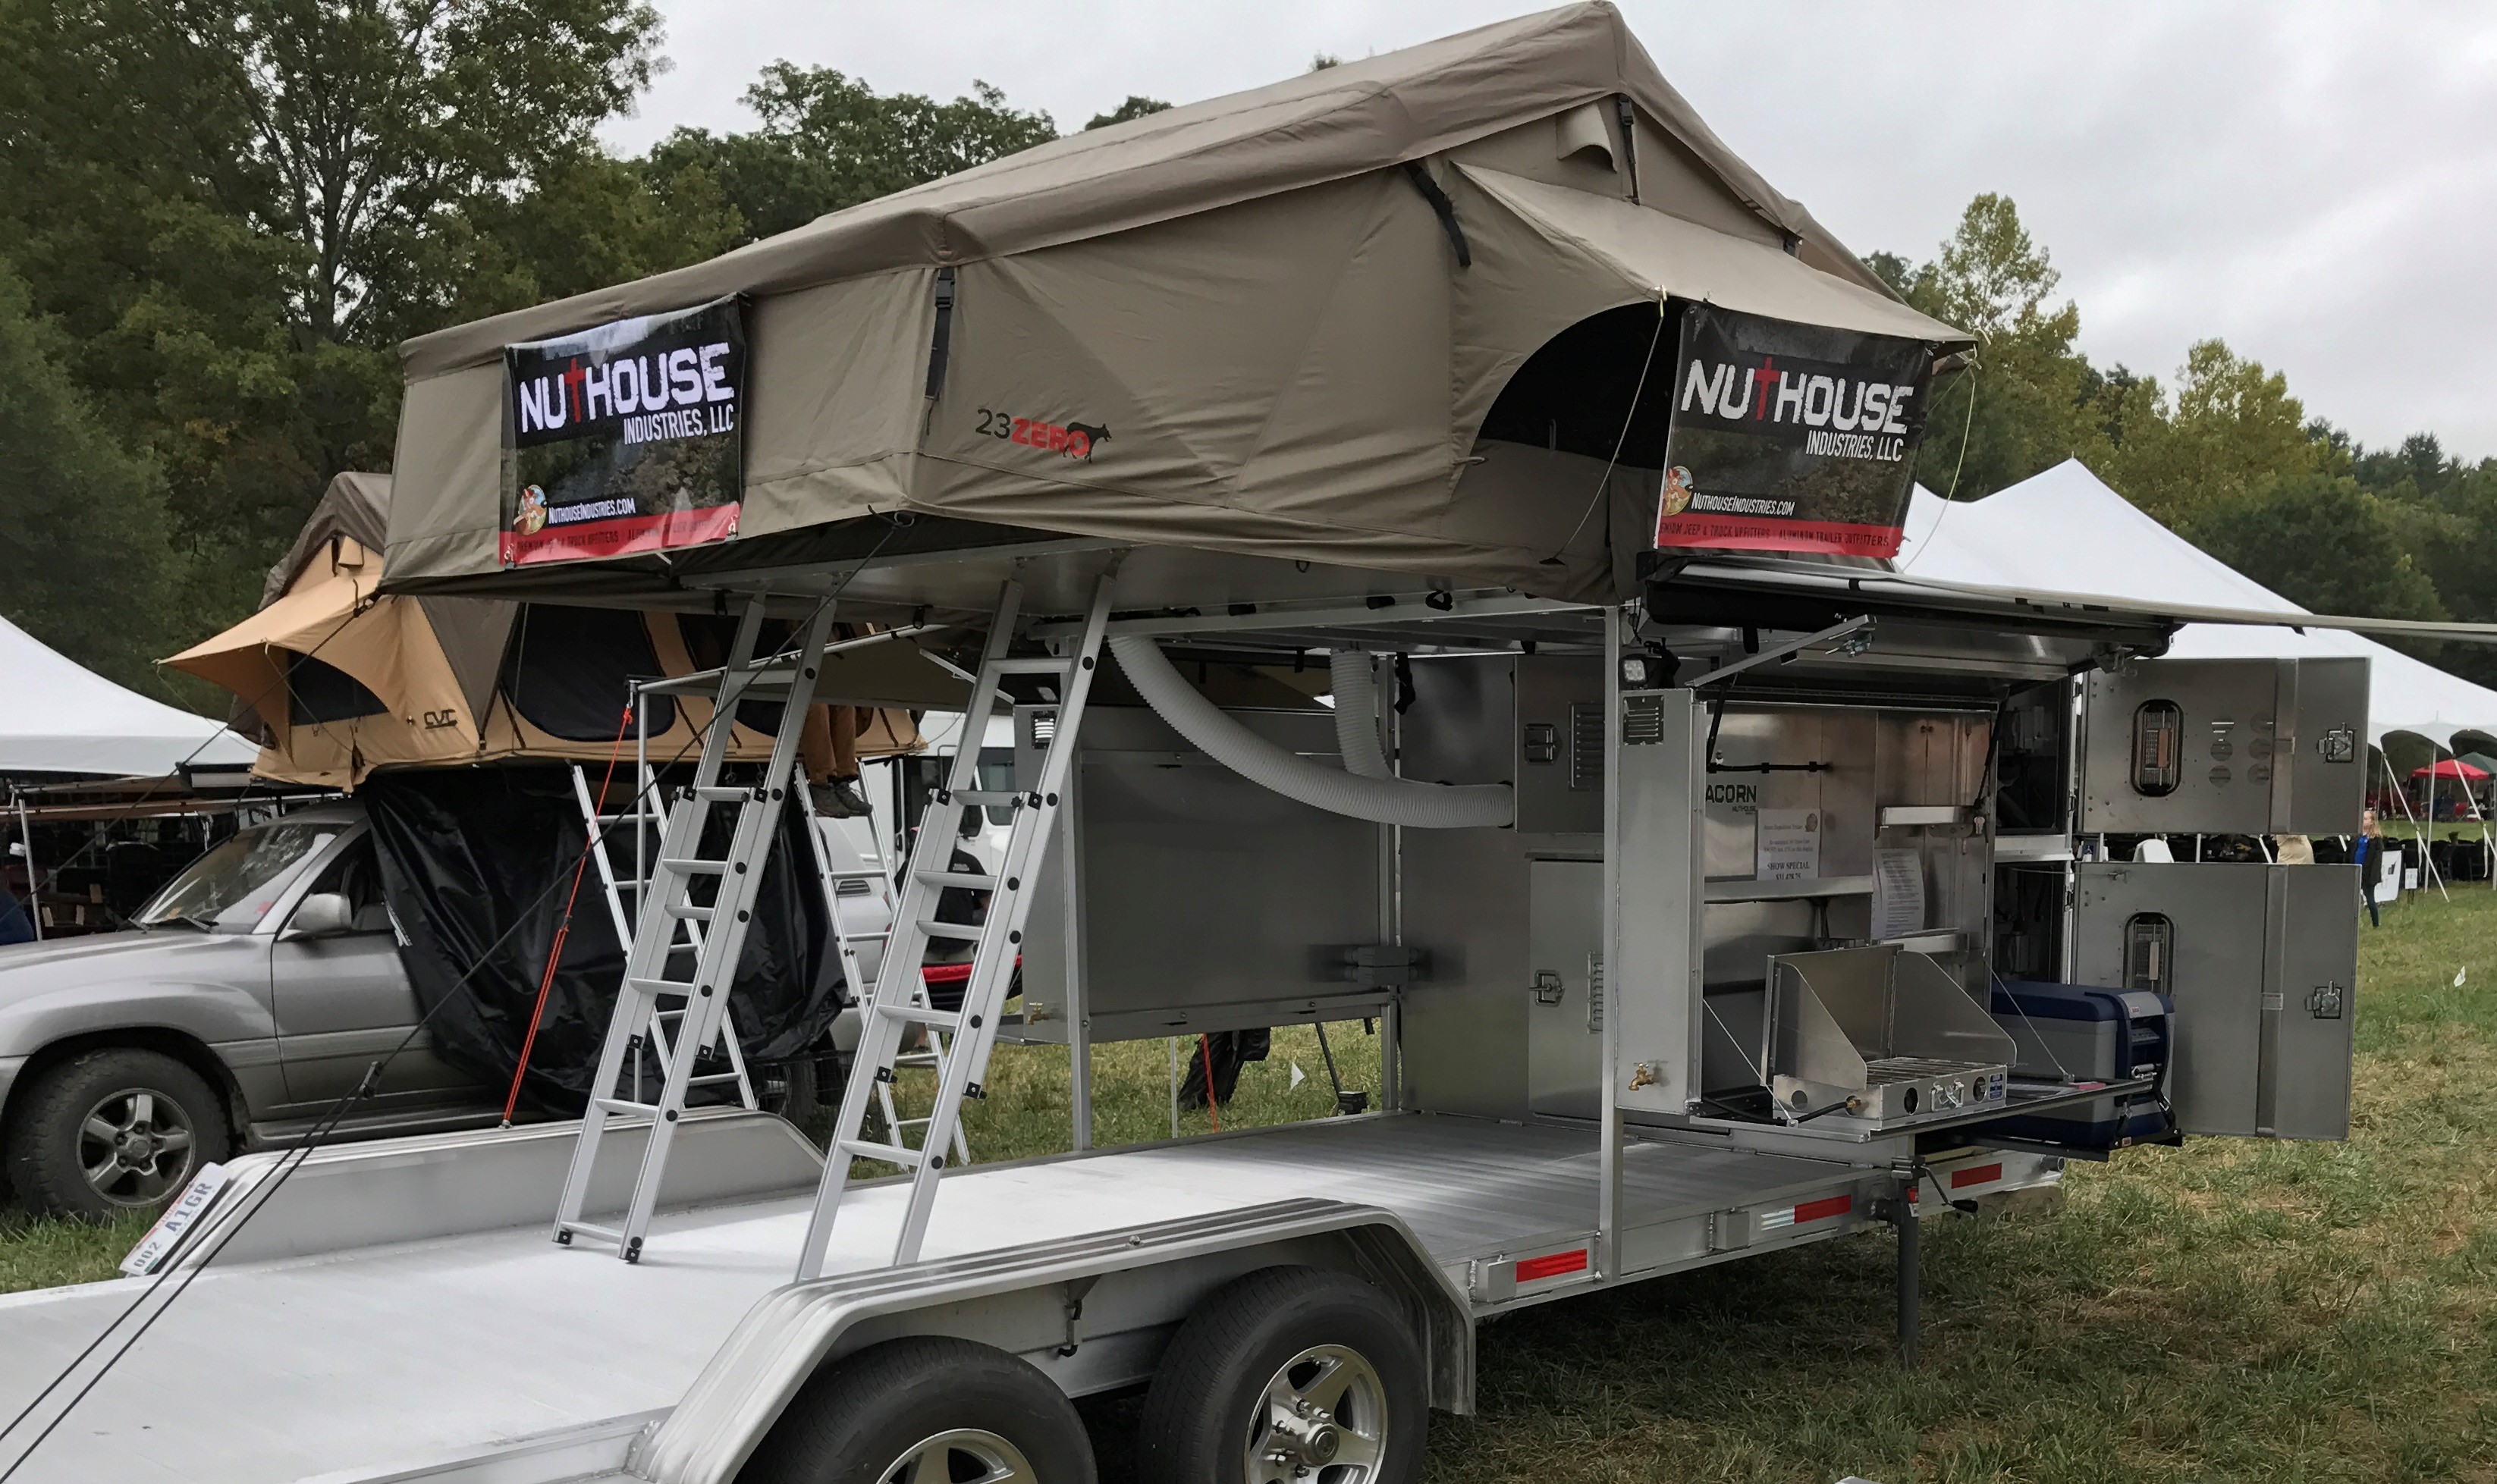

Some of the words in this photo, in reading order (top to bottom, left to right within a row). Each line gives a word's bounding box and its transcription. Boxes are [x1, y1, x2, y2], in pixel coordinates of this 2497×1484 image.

[520, 341, 735, 434] NUTHOUSE
[1680, 356, 1914, 435] NUTHOUSE
[623, 410, 708, 446] INDUSTRIES,
[710, 403, 735, 435] LLC
[975, 408, 1091, 456] 23ZERO
[1806, 429, 1874, 462] INDUSTRIES,
[1877, 435, 1904, 462] LLC
[1710, 525, 1733, 537] TRUCK
[1816, 532, 1842, 544] TRAILER
[1845, 533, 1889, 547] OUTFITTERS
[1705, 784, 1757, 804] ACORN
[133, 1241, 162, 1268] 002
